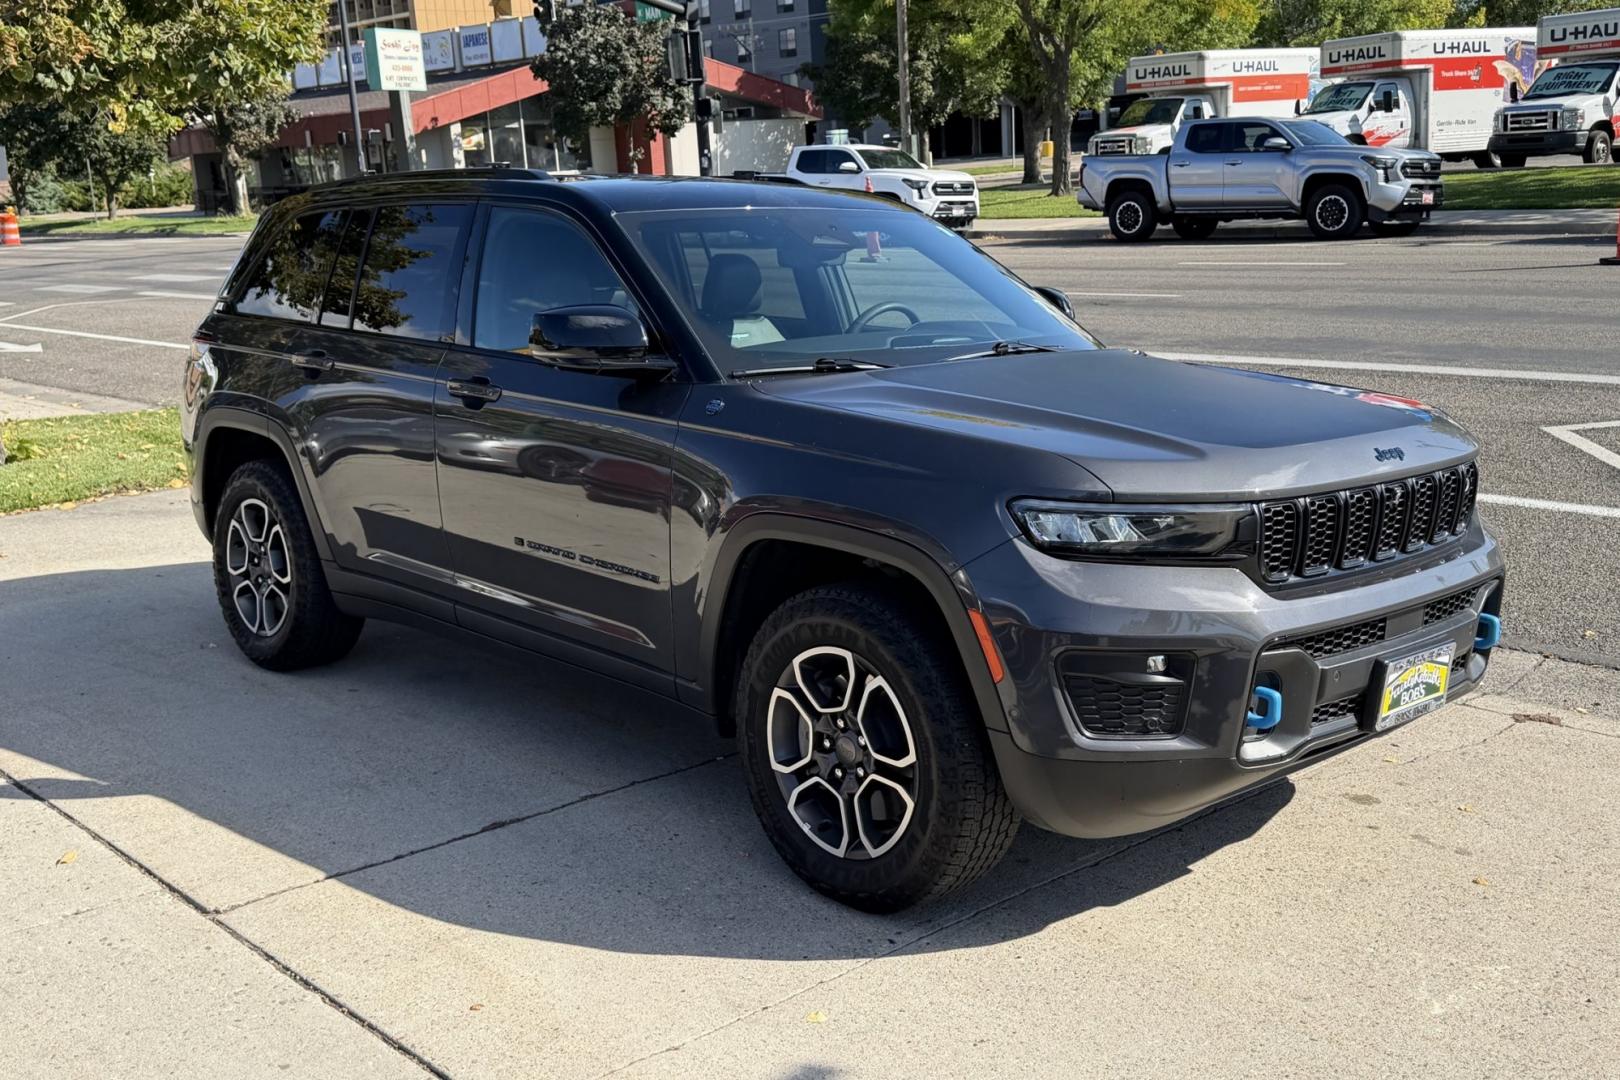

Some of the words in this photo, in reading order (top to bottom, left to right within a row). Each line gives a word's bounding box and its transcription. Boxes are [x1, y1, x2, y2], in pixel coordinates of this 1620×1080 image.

[462, 31, 488, 48] JAPANESE
[1551, 22, 1619, 42] U-HAU
[1328, 46, 1386, 64] U-HAUL
[1433, 41, 1491, 54] U-HAUL
[1135, 64, 1191, 80] U-HAUL
[1233, 61, 1279, 73] U-HAUL
[1552, 71, 1592, 81] RIGHT
[1373, 447, 1405, 462] Jeep
